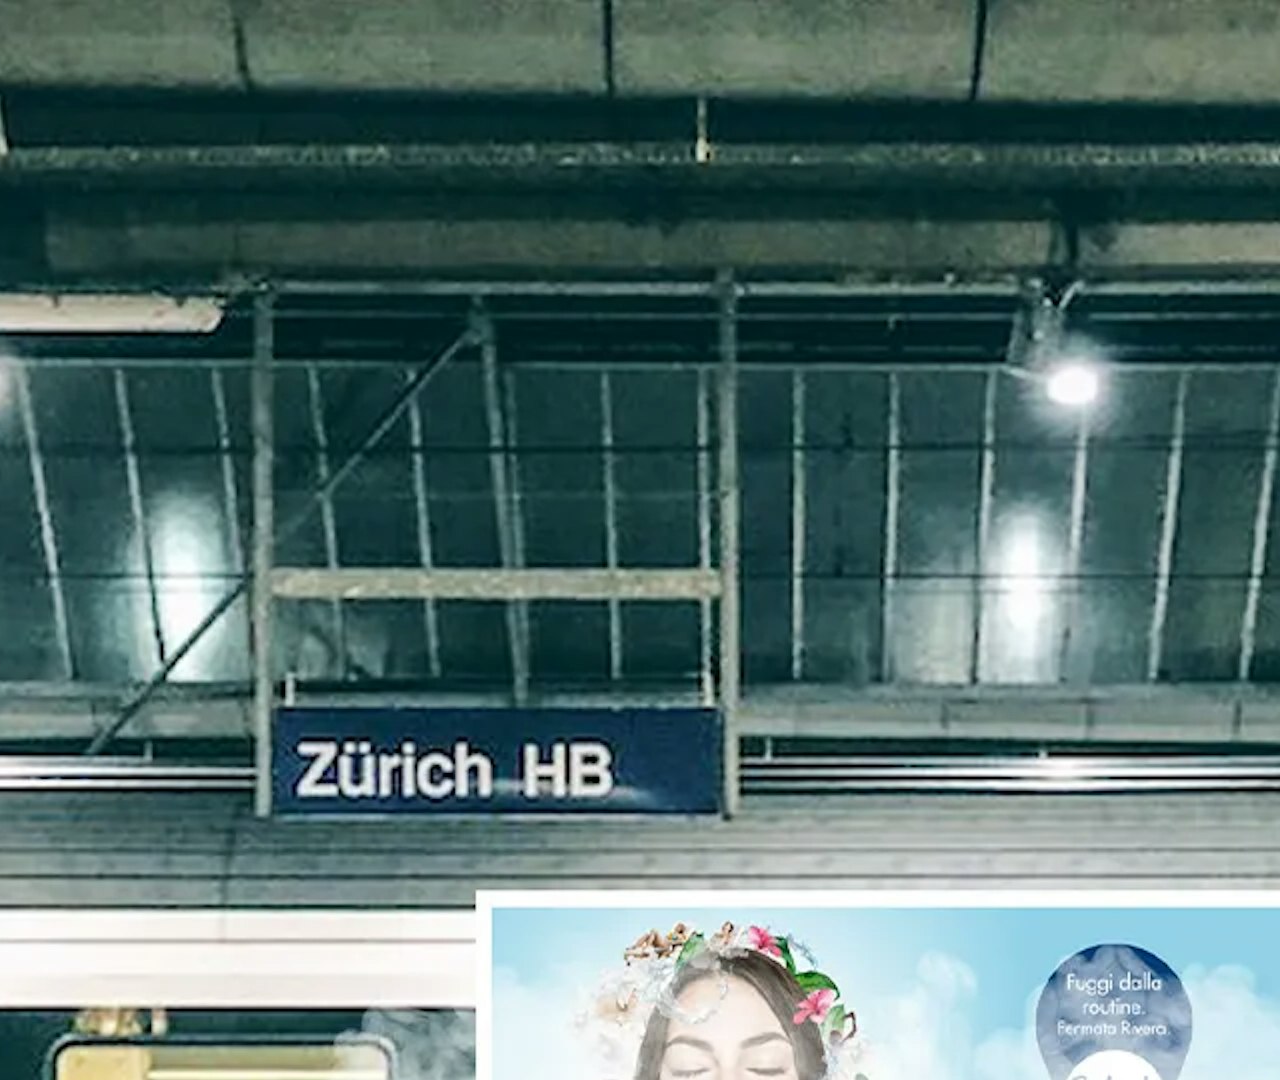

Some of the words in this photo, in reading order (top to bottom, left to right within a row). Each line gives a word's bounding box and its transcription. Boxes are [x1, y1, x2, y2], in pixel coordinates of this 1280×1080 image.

[296, 741, 492, 798] Zürich
[523, 742, 614, 798] HB
[1066, 972, 1114, 997] Fuggi
[1119, 971, 1162, 992] dalla
[1082, 998, 1147, 1016] routine.
